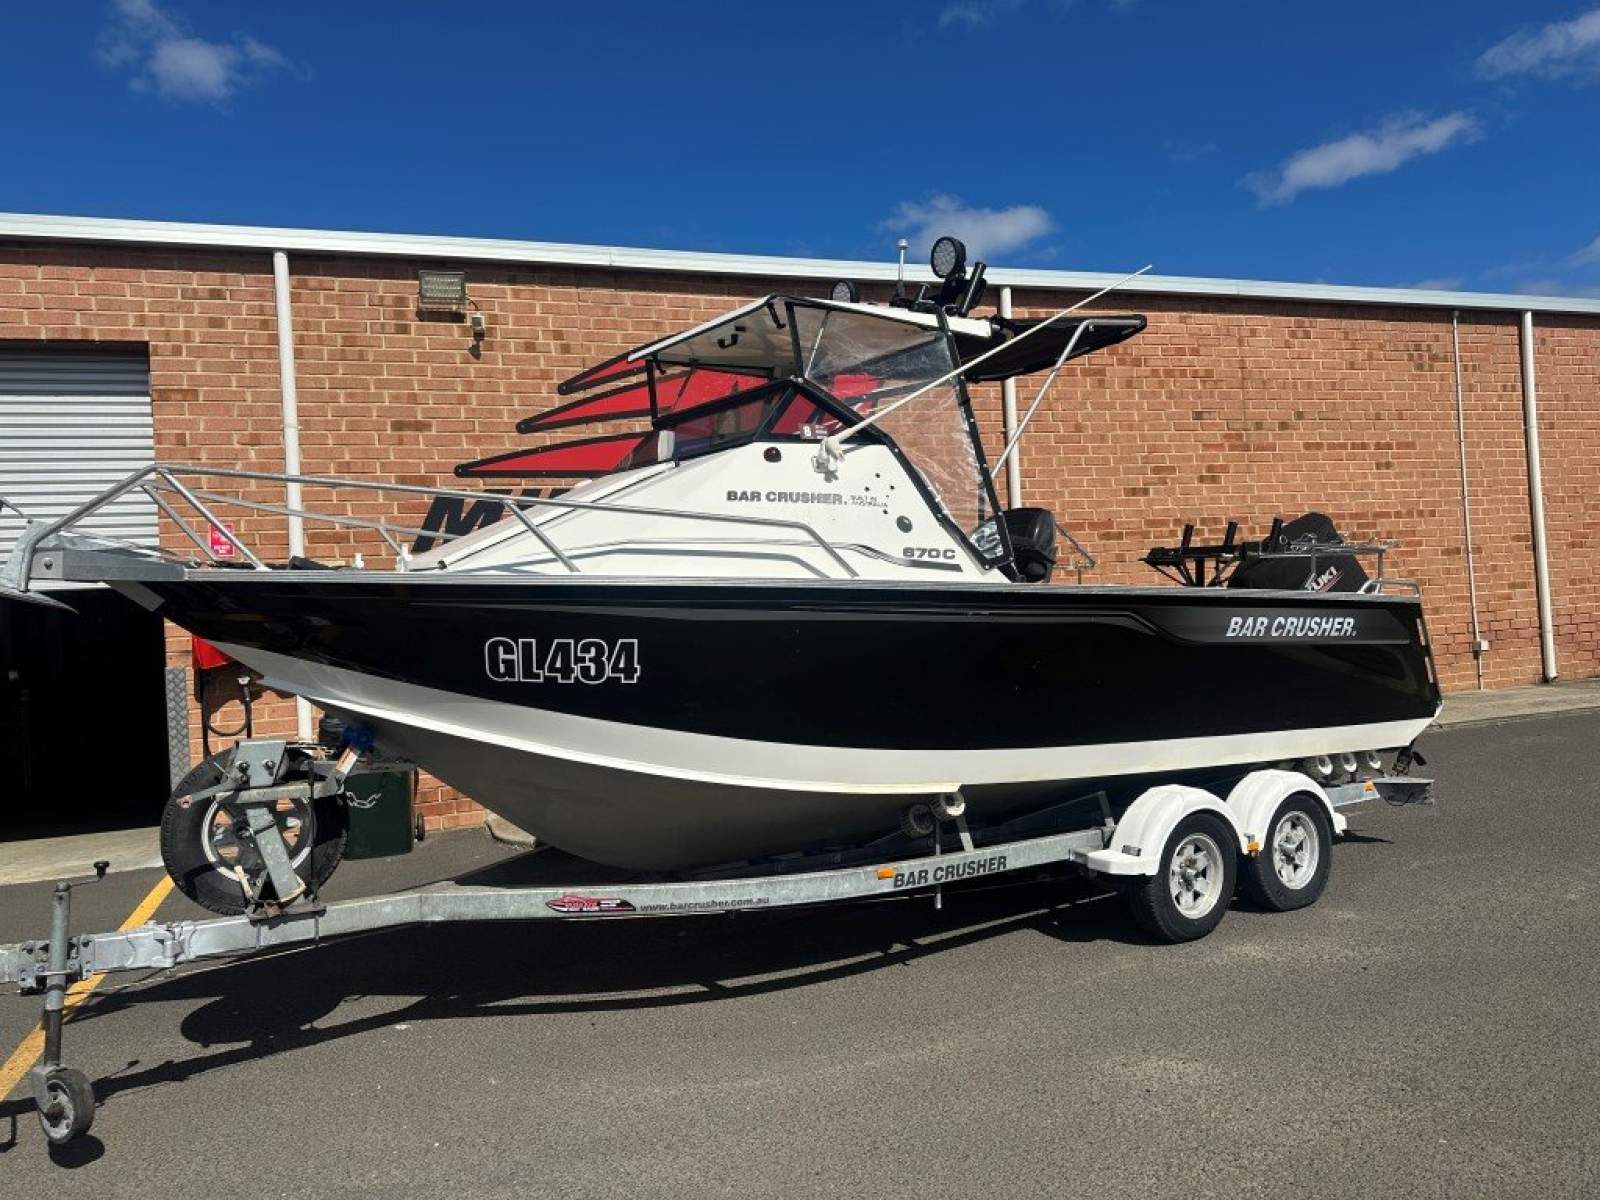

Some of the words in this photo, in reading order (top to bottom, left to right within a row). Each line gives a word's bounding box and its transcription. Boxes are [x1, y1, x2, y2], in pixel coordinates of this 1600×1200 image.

[726, 490, 762, 503] BAR
[1225, 616, 1268, 637] BAR
[484, 637, 641, 684] GL434
[893, 869, 929, 888] BAR
[932, 855, 1007, 881] CRUSHER
[639, 896, 770, 912] www.barcrusher.com.au
